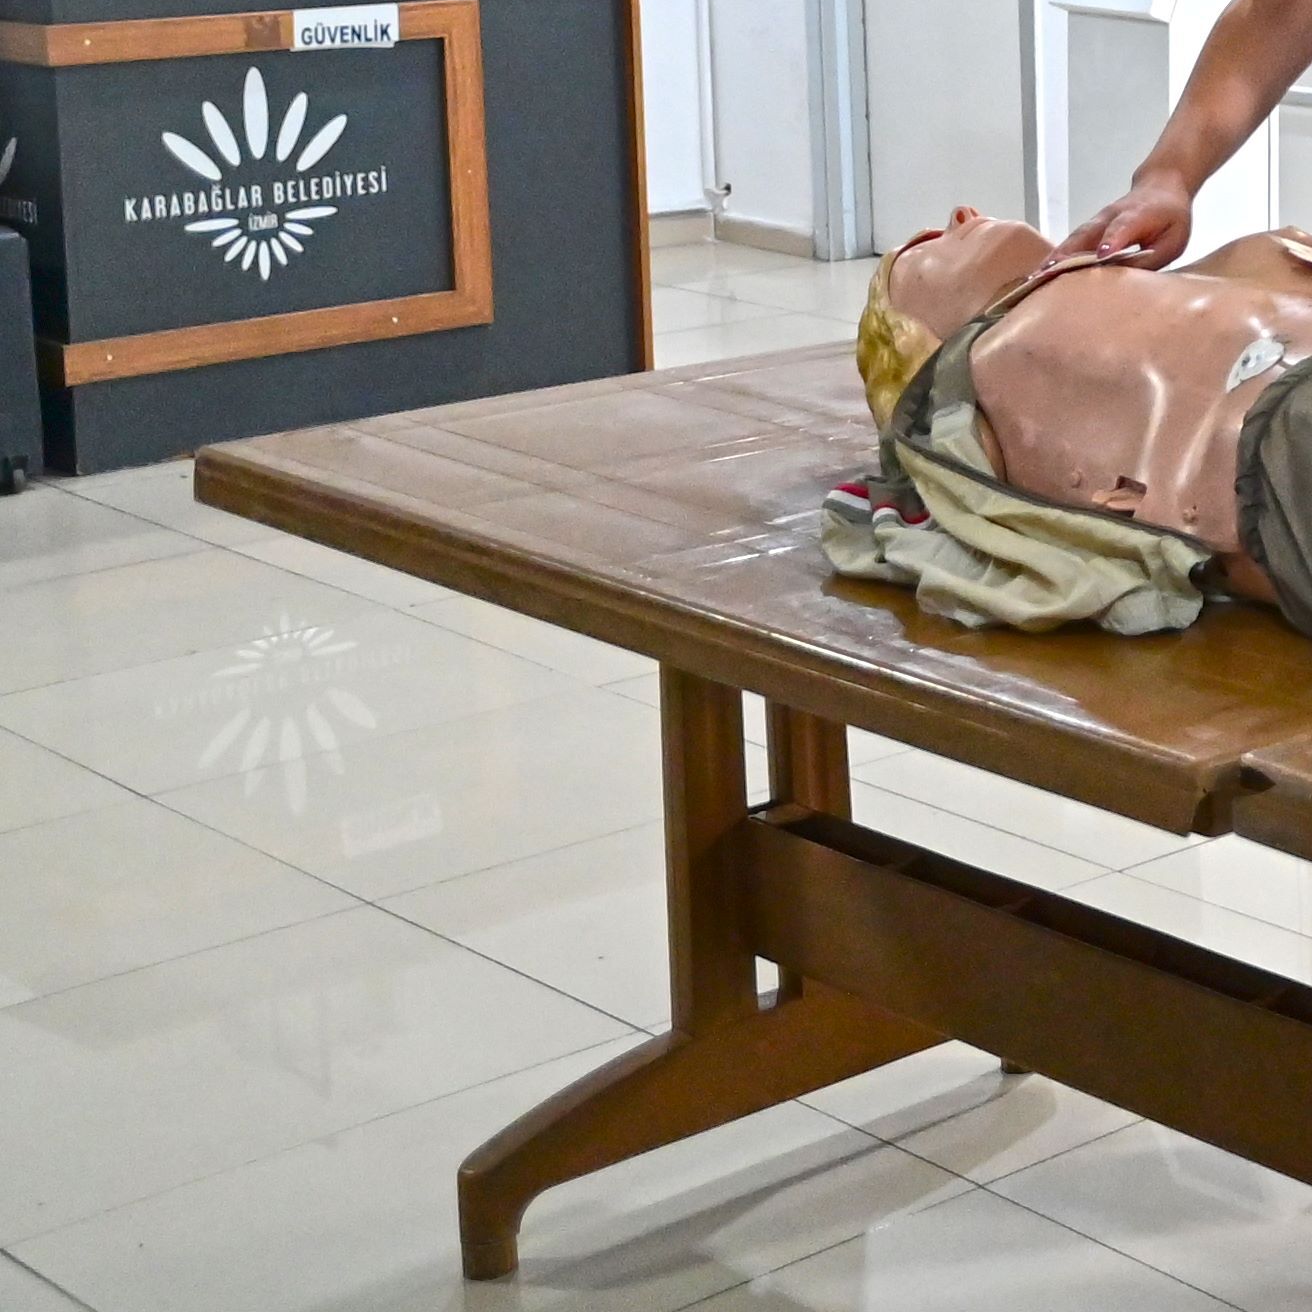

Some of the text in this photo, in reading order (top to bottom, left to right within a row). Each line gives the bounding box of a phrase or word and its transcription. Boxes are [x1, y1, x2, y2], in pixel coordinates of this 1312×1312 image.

[301, 18, 392, 46] GÜVENLİK
[124, 165, 389, 223] KARABAĞLAR BELEDİYESİ
[248, 211, 279, 231] İZMİR
